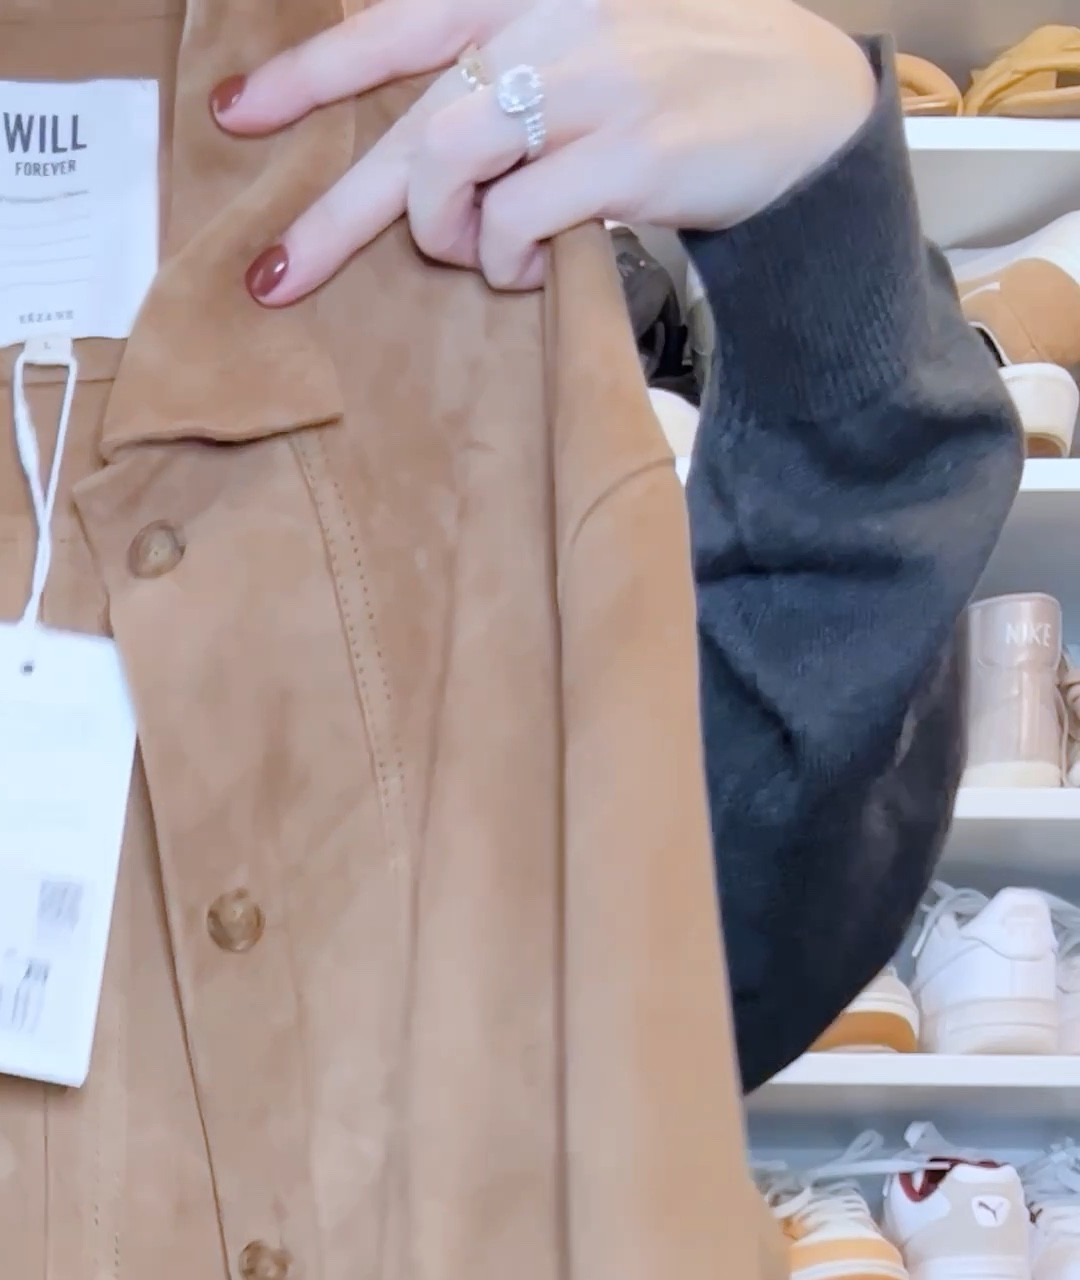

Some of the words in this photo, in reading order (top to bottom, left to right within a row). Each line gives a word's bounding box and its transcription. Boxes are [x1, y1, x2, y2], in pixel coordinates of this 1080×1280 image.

[3, 112, 87, 153] WILL
[15, 159, 76, 177] FOREVER
[1005, 622, 1051, 647] NIKE
